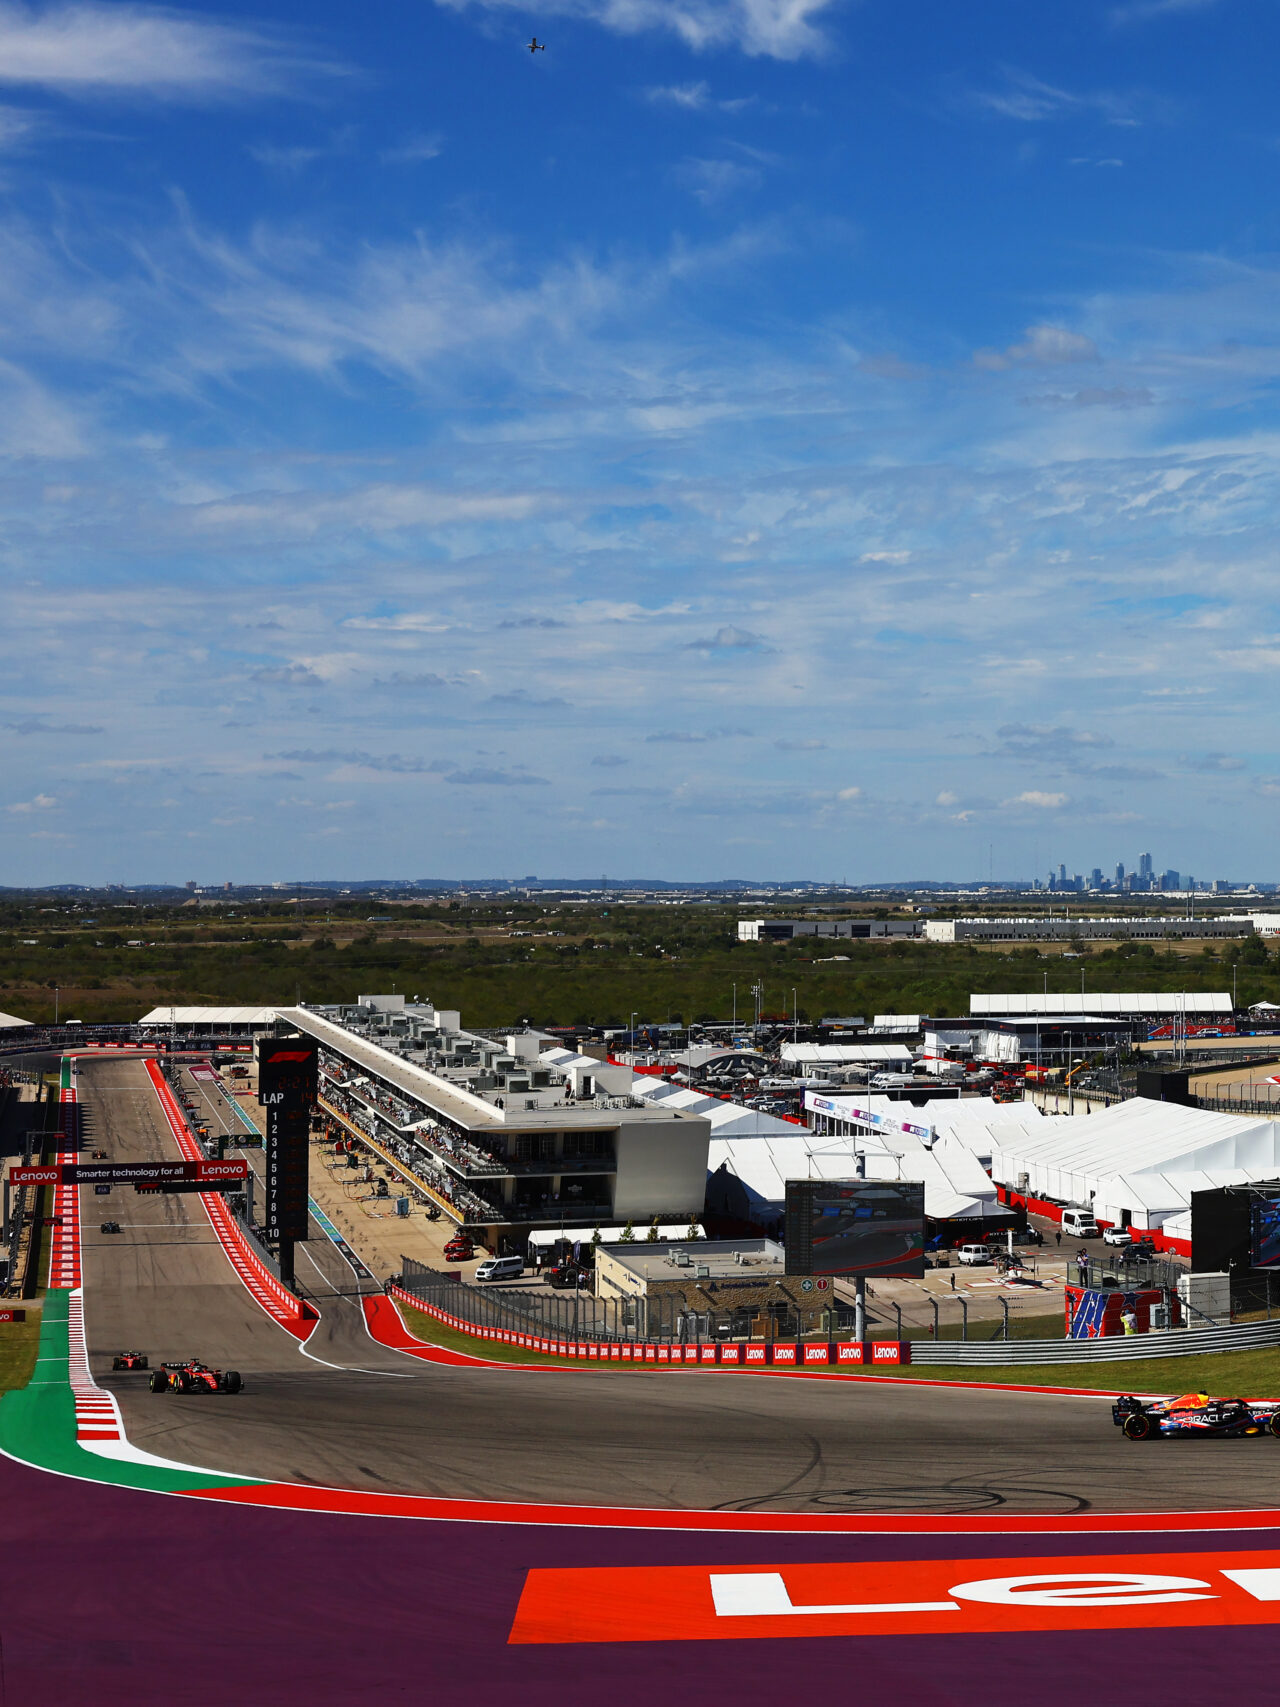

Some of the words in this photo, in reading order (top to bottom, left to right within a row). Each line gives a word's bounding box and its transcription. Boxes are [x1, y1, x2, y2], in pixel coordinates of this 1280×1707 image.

[263, 1093, 284, 1103] LAP
[273, 1112, 277, 1120] 1
[272, 1125, 278, 1133] 2
[271, 1138, 277, 1146] 3
[271, 1151, 277, 1159] 4
[76, 1169, 110, 1178] Smarter
[112, 1168, 160, 1179] technology
[161, 1168, 173, 1176] for
[174, 1167, 184, 1175] all
[201, 1164, 244, 1175] Lenovo
[271, 1164, 277, 1172] 5
[14, 1171, 58, 1181] Lenovo
[271, 1177, 277, 1185] 6
[271, 1190, 277, 1198] 7
[271, 1203, 276, 1211] 8
[271, 1216, 276, 1224] 9
[268, 1229, 279, 1237] 10
[702, 1347, 715, 1358] Lenovo
[722, 1347, 738, 1359] Lenovo
[746, 1347, 764, 1359] Lenovo
[774, 1347, 794, 1359] Lenovo
[806, 1347, 827, 1359] Lenovo
[839, 1346, 861, 1359] Lenovo
[874, 1345, 898, 1359] Lenovo
